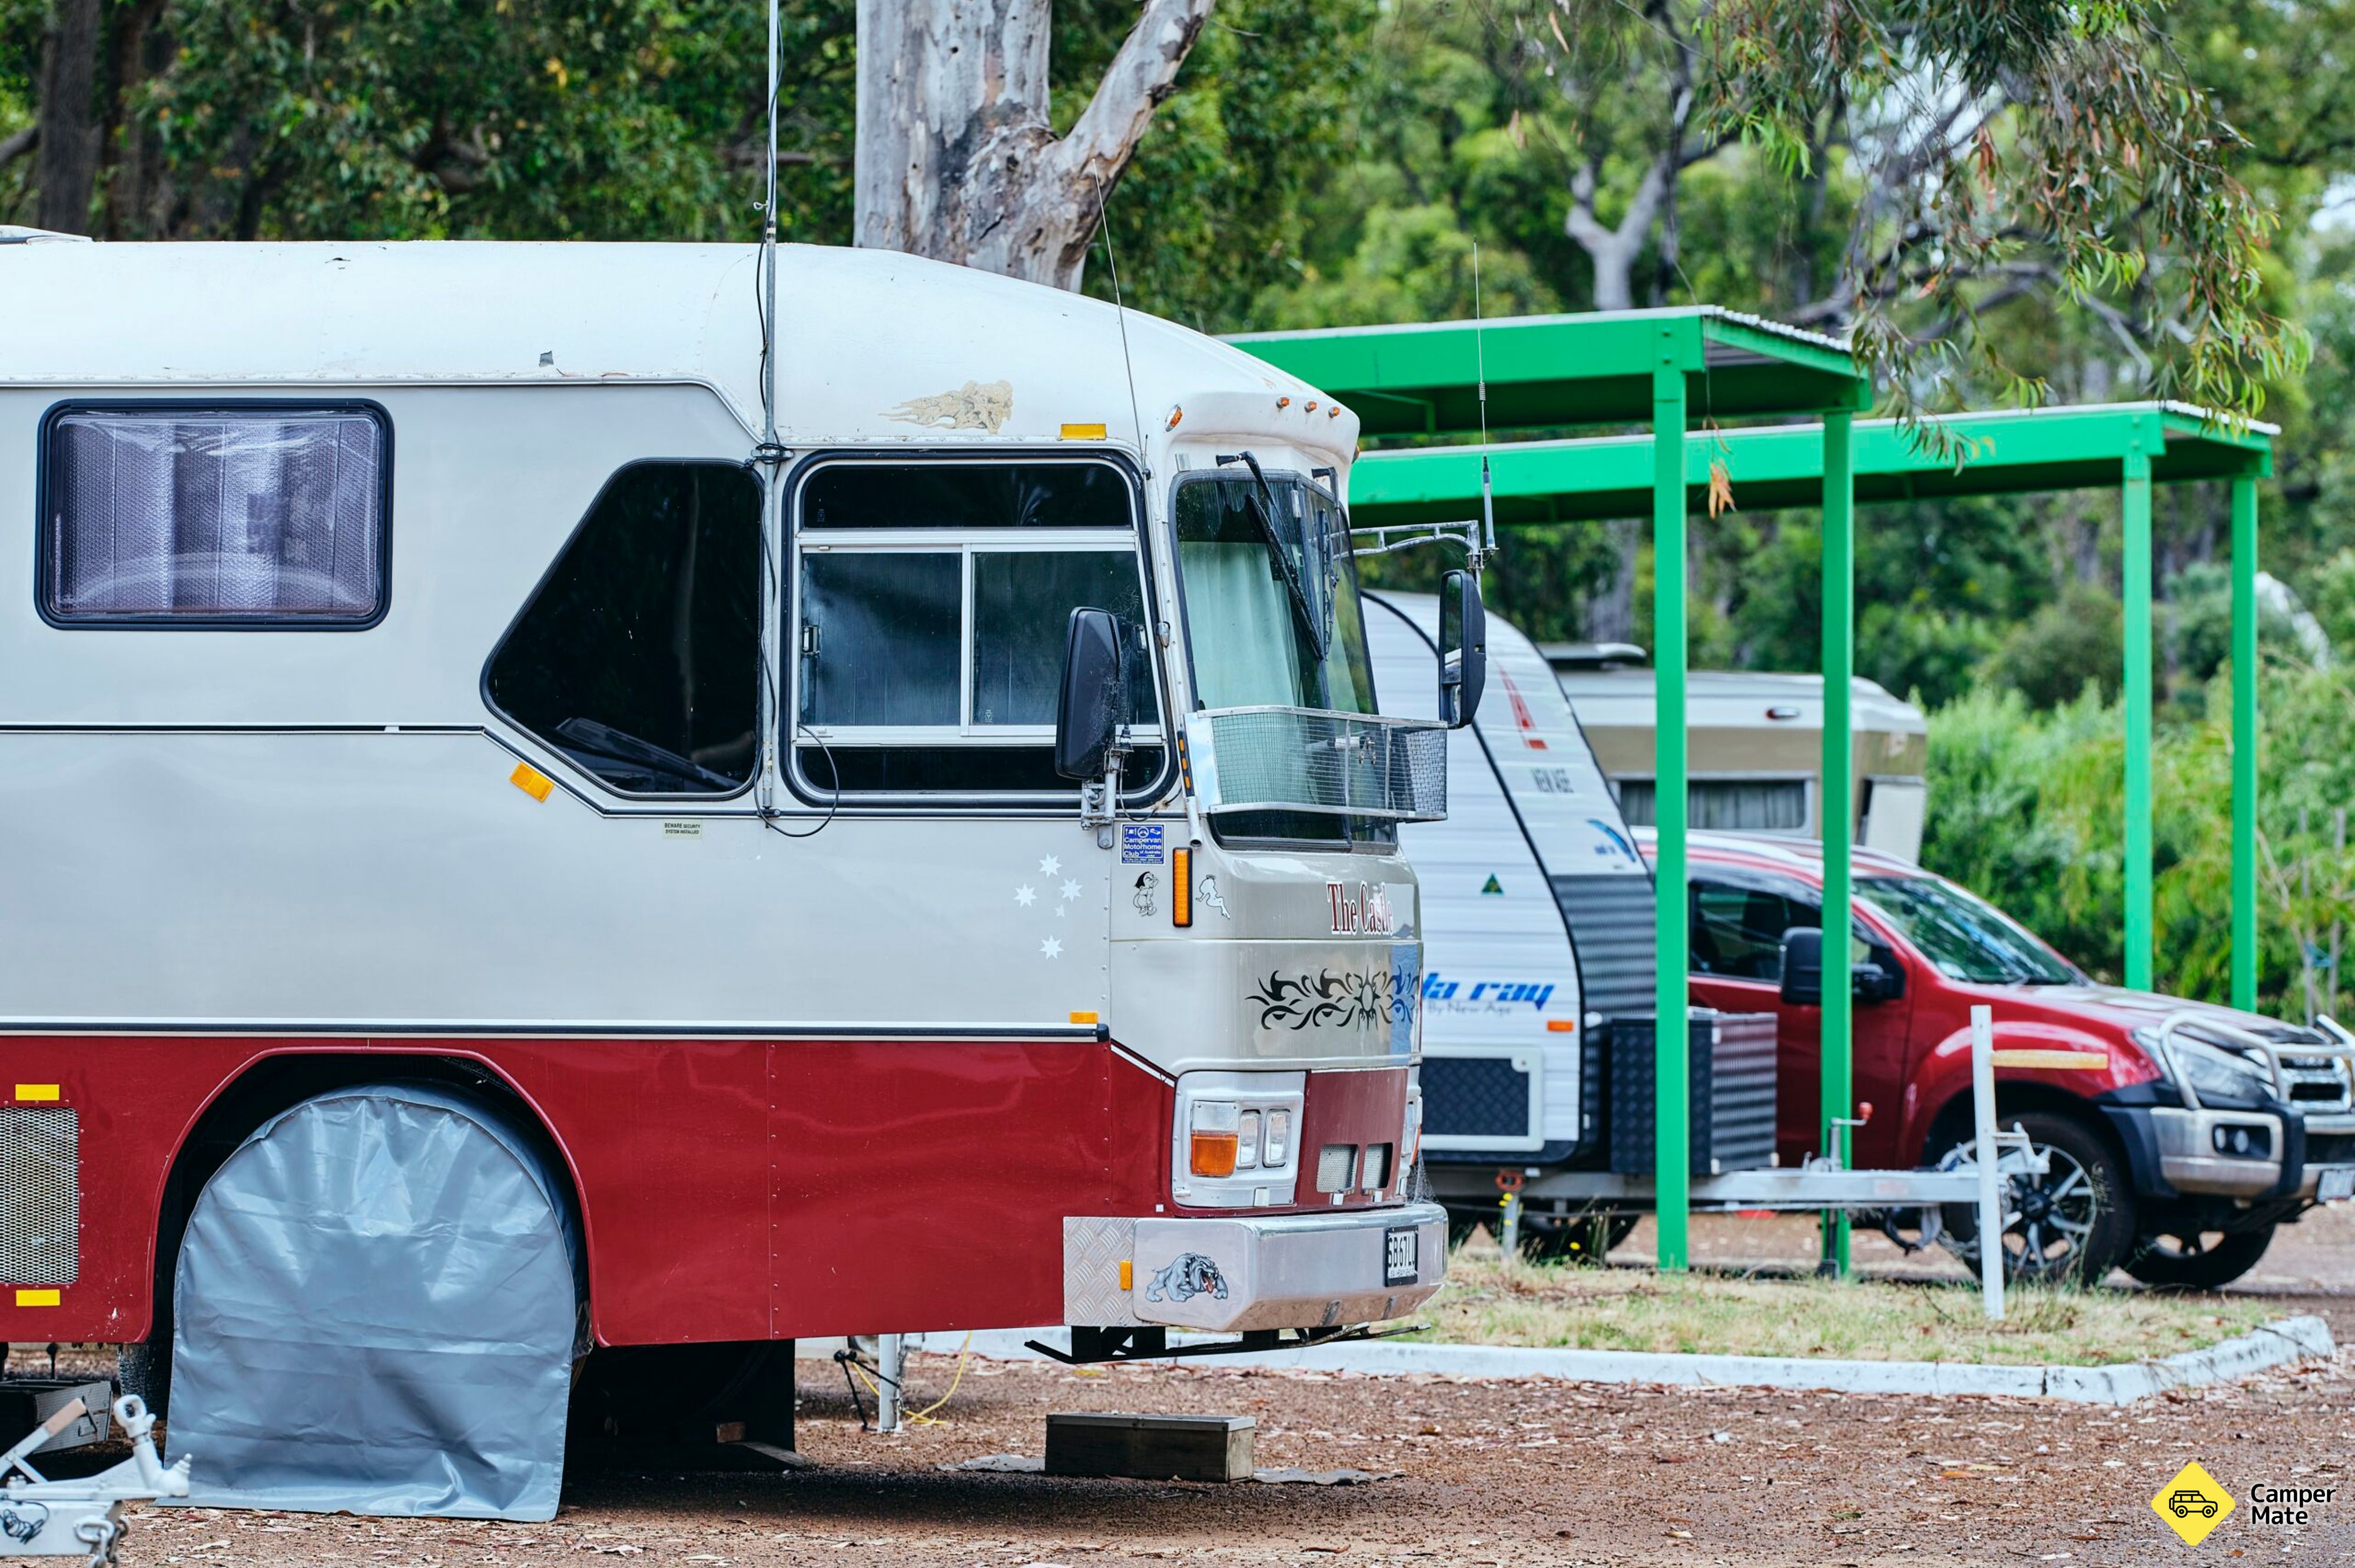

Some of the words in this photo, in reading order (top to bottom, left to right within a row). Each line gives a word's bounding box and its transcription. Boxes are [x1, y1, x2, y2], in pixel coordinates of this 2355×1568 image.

[1326, 881, 1358, 935] The
[1359, 881, 1394, 936] Castle
[1469, 982, 1555, 1012] ray
